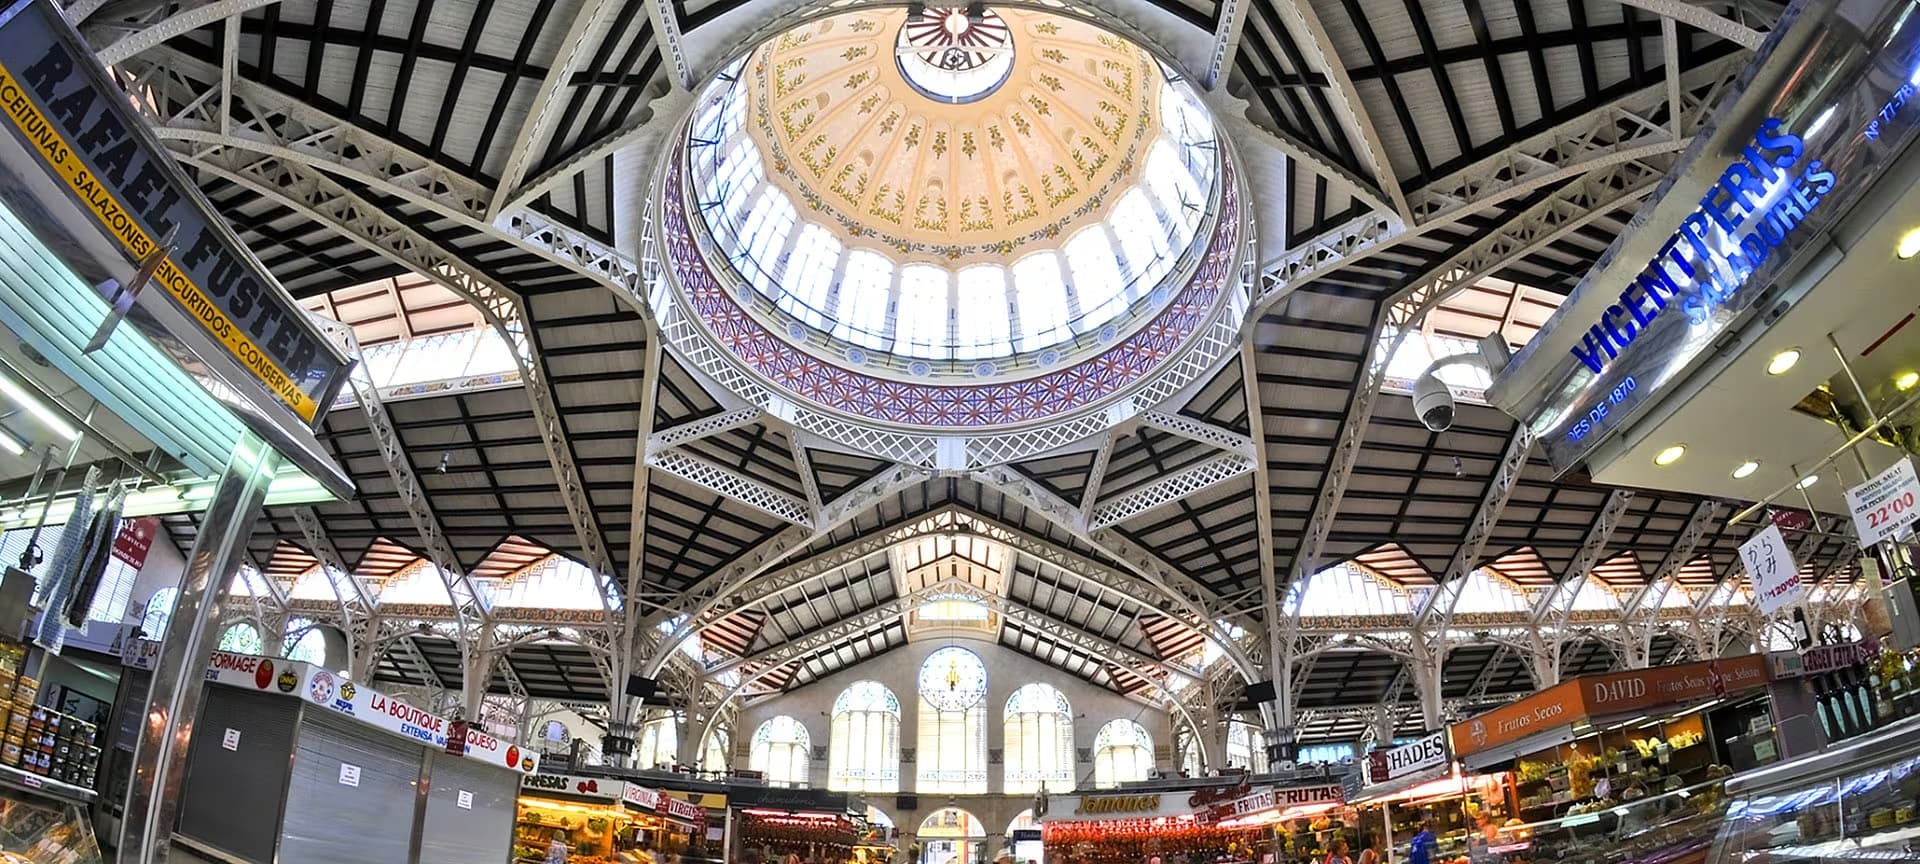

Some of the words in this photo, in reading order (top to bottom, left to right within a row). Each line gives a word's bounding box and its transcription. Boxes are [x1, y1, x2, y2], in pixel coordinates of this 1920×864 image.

[1864, 119, 1880, 141] Nº
[1879, 83, 1914, 125] 77-78
[0, 73, 68, 164] ACEITUNAS
[73, 170, 151, 256] SALAZONES
[22, 41, 181, 239] RAFAEL
[182, 226, 317, 383] FUSTER
[1569, 232, 1695, 375] VICENT
[1679, 117, 1805, 261] PERIS
[1681, 158, 1837, 326] SALADURES
[156, 260, 231, 339] ENCURTIDOS
[238, 341, 303, 407] CONSERVAS
[1588, 401, 1609, 425] DE
[1608, 375, 1637, 406] 1870
[1866, 491, 1914, 529] 22'00
[209, 652, 257, 673] FORMAGE
[1594, 678, 1646, 703] DAVID
[370, 694, 387, 714] LA
[389, 701, 443, 733] BOUTIQUE
[467, 730, 498, 752] QUESO
[401, 723, 433, 742] EXTENSA
[1498, 714, 1531, 735] Frutos
[1534, 703, 1563, 721] Secos
[524, 775, 569, 791] FRESAS
[1238, 792, 1273, 812] FRUTAS
[1275, 786, 1341, 805] FRUTAS
[1074, 794, 1161, 815] Jamones
